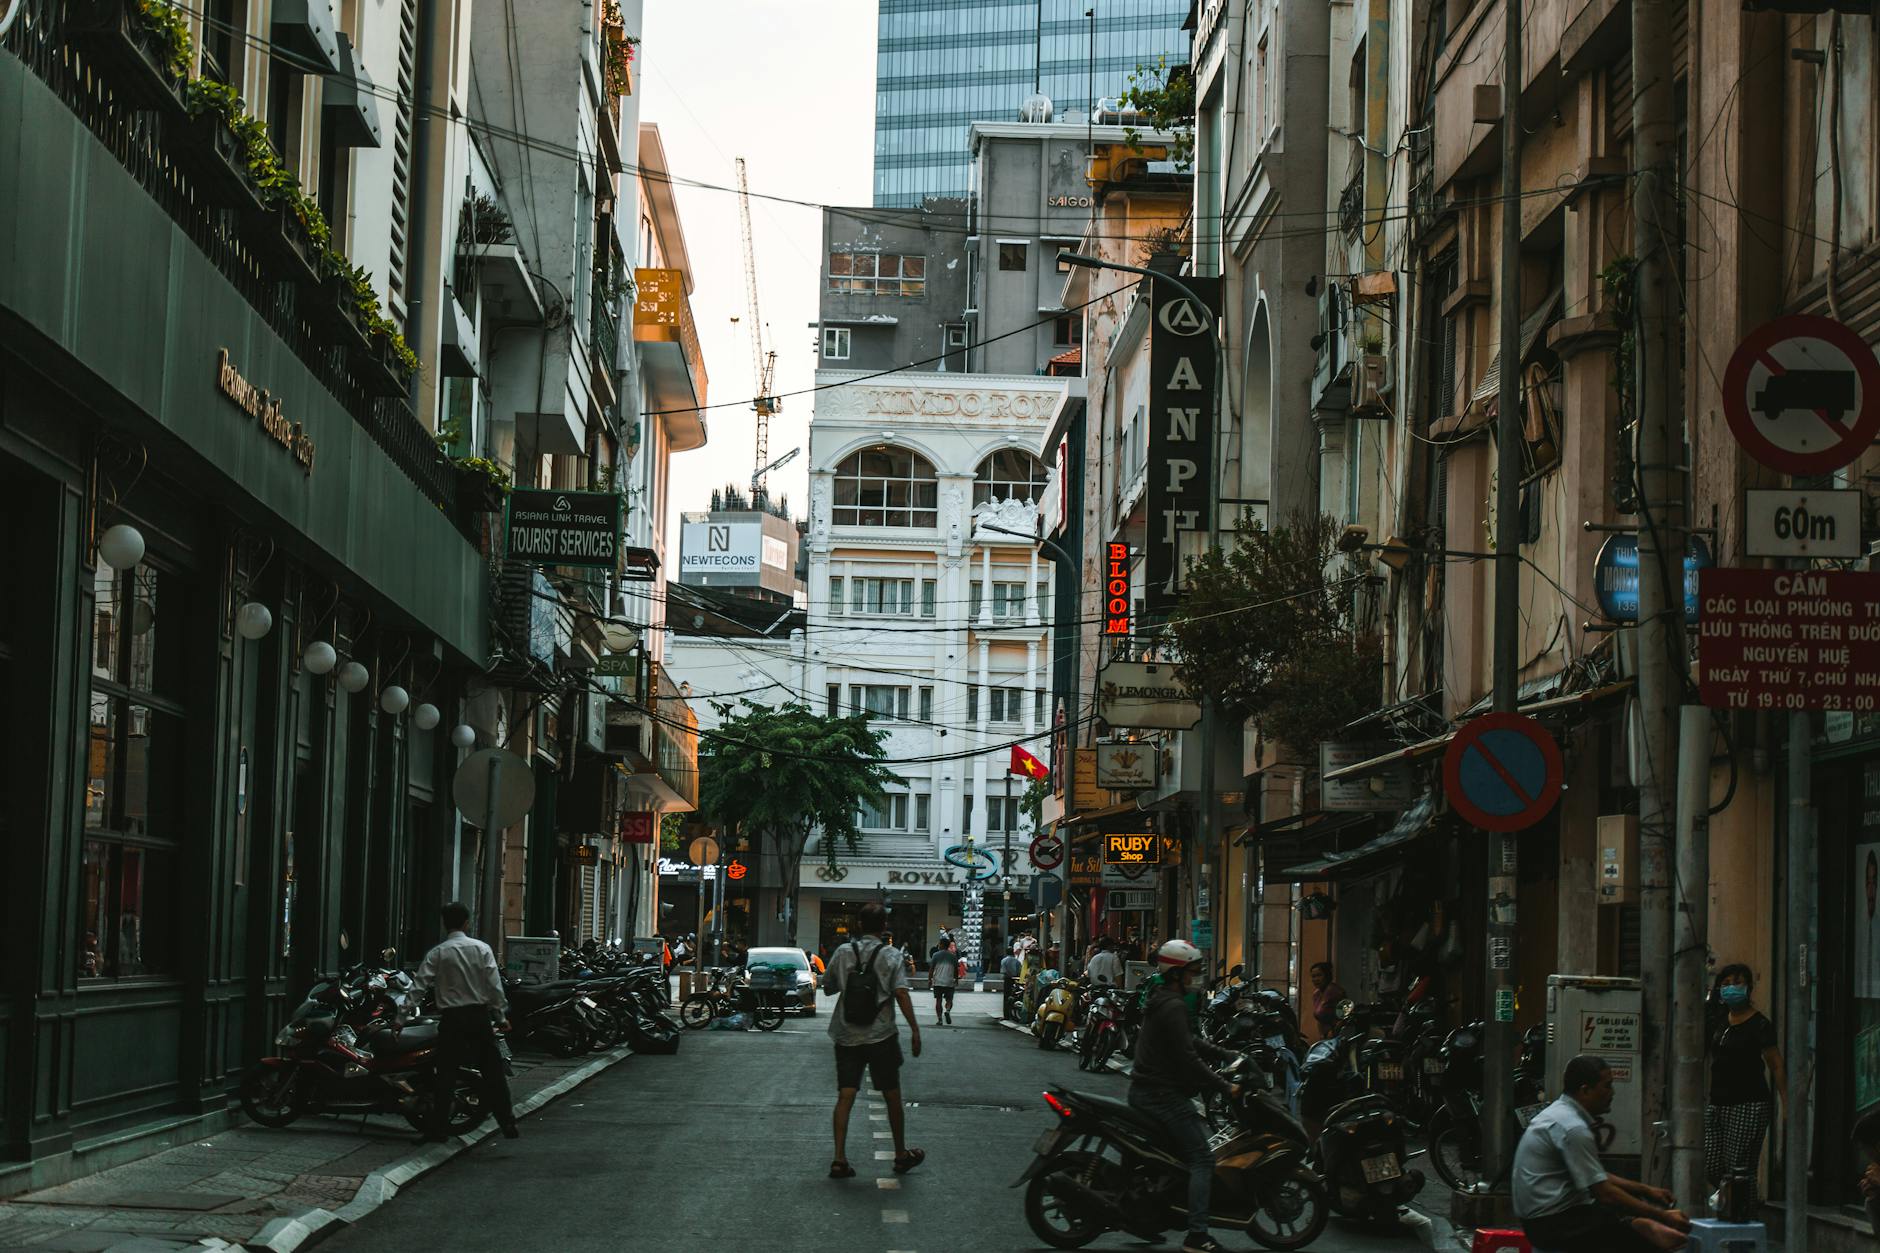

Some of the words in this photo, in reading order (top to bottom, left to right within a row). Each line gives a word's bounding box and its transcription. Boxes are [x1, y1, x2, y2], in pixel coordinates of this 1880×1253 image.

[515, 511, 550, 521] ASIANA
[551, 514, 572, 523] LINK
[574, 514, 609, 525] TRAVEL
[1773, 506, 1837, 541] 60m
[512, 526, 559, 555] TOURIST
[559, 528, 614, 557] SERVICES
[683, 555, 756, 566] NEWTECONS
[1107, 543, 1129, 634] BLOOM
[1705, 594, 1738, 614] CÁC
[1744, 598, 1780, 620] LOẠI
[1787, 600, 1854, 618] PHƯƠNG
[1701, 619, 1733, 638] LƯU
[1738, 620, 1793, 640] THÔNG
[1799, 622, 1843, 641] TRÊN
[1742, 642, 1810, 664] NGUYỄN
[1818, 645, 1852, 669] HUỆ
[600, 660, 631, 673] SPA
[1708, 665, 1751, 683] NGÀY
[1759, 665, 1792, 685] THỨ
[1110, 836, 1154, 852] RUBY
[1120, 851, 1144, 863] Shop
[888, 870, 960, 886] ROYAL
